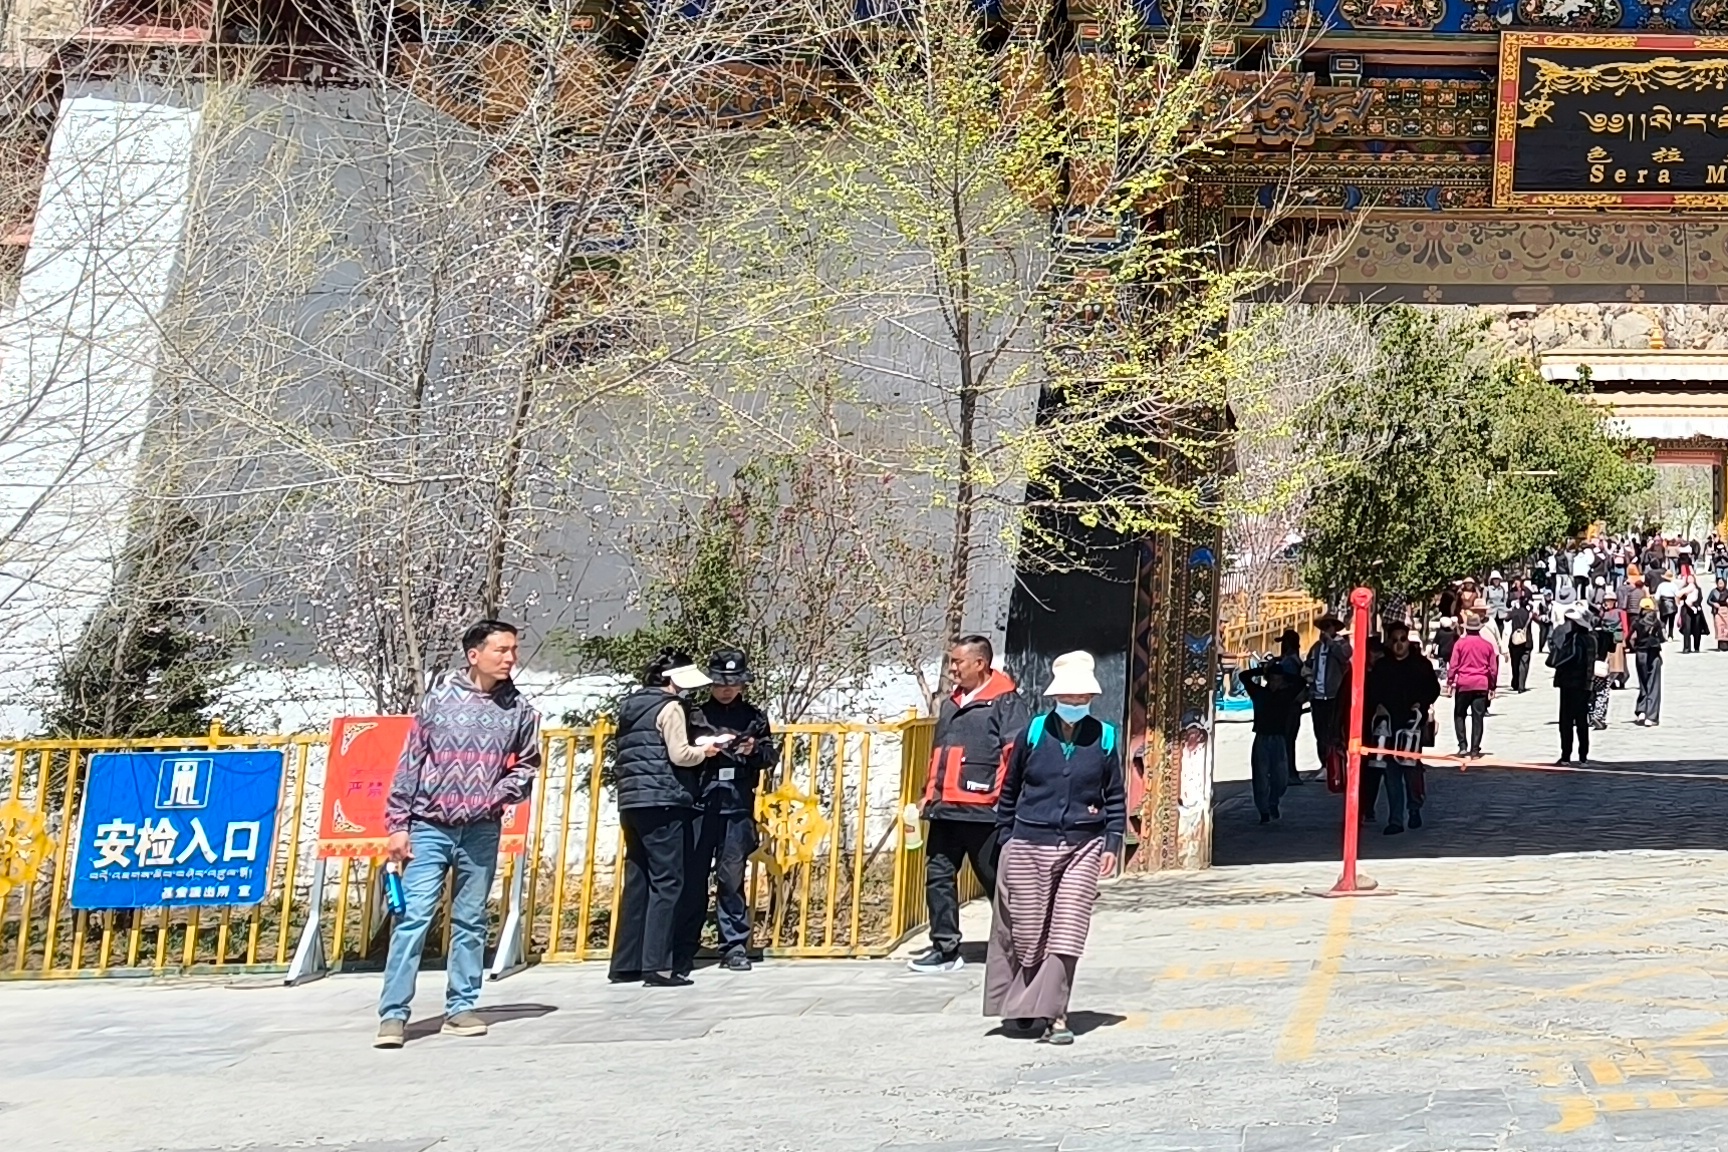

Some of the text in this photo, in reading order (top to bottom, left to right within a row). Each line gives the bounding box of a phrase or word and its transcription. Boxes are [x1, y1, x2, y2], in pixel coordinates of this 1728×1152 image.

[1589, 164, 1672, 184] Sera
[93, 817, 261, 868] 安检入口
